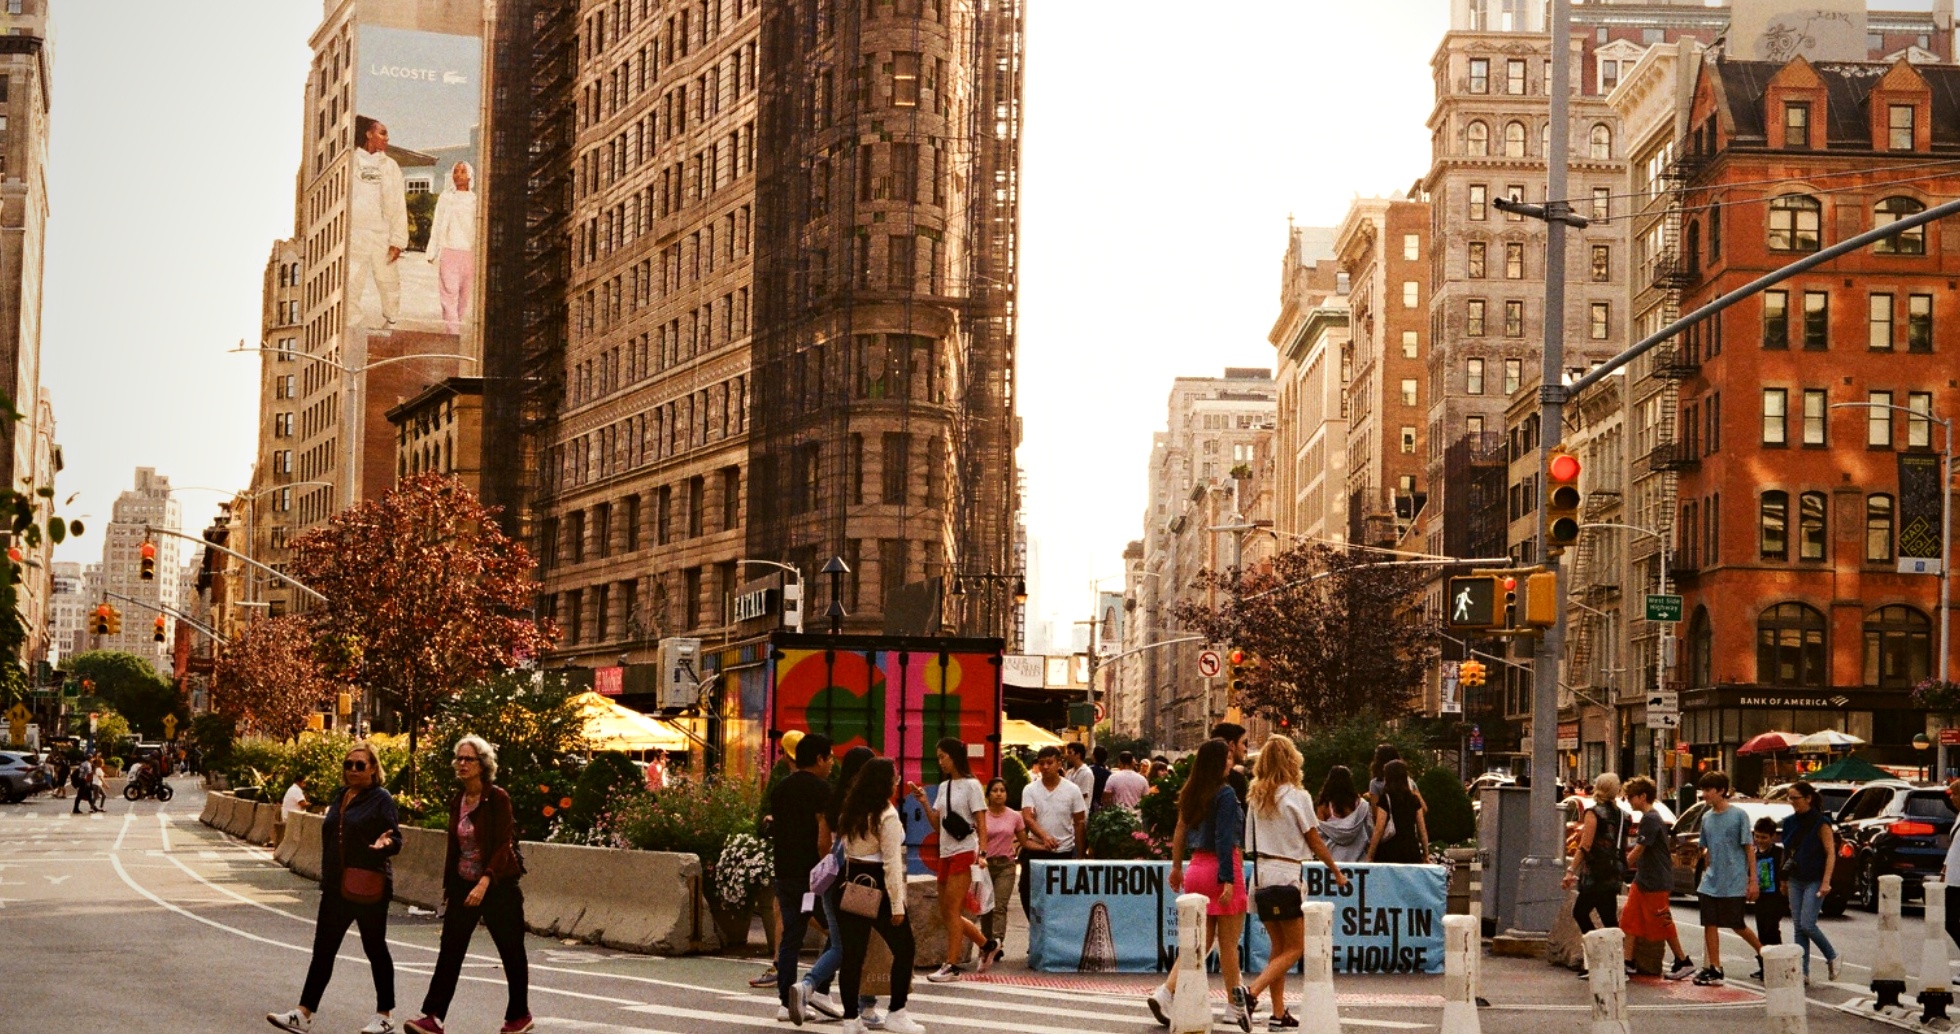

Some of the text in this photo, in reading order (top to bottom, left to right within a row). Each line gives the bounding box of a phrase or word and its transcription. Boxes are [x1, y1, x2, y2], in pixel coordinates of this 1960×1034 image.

[371, 64, 437, 80] LACOSTE
[734, 589, 767, 623] EATALY
[1648, 597, 1664, 605] West
[1649, 605, 1678, 613] Highway
[1740, 697, 1767, 705] BANK
[1783, 698, 1828, 706] AMERICA
[1045, 865, 1163, 896] FLATIRON
[1307, 867, 1370, 897] BEST
[1341, 907, 1432, 937] SEAT IN
[1346, 945, 1428, 973] HOUSE
